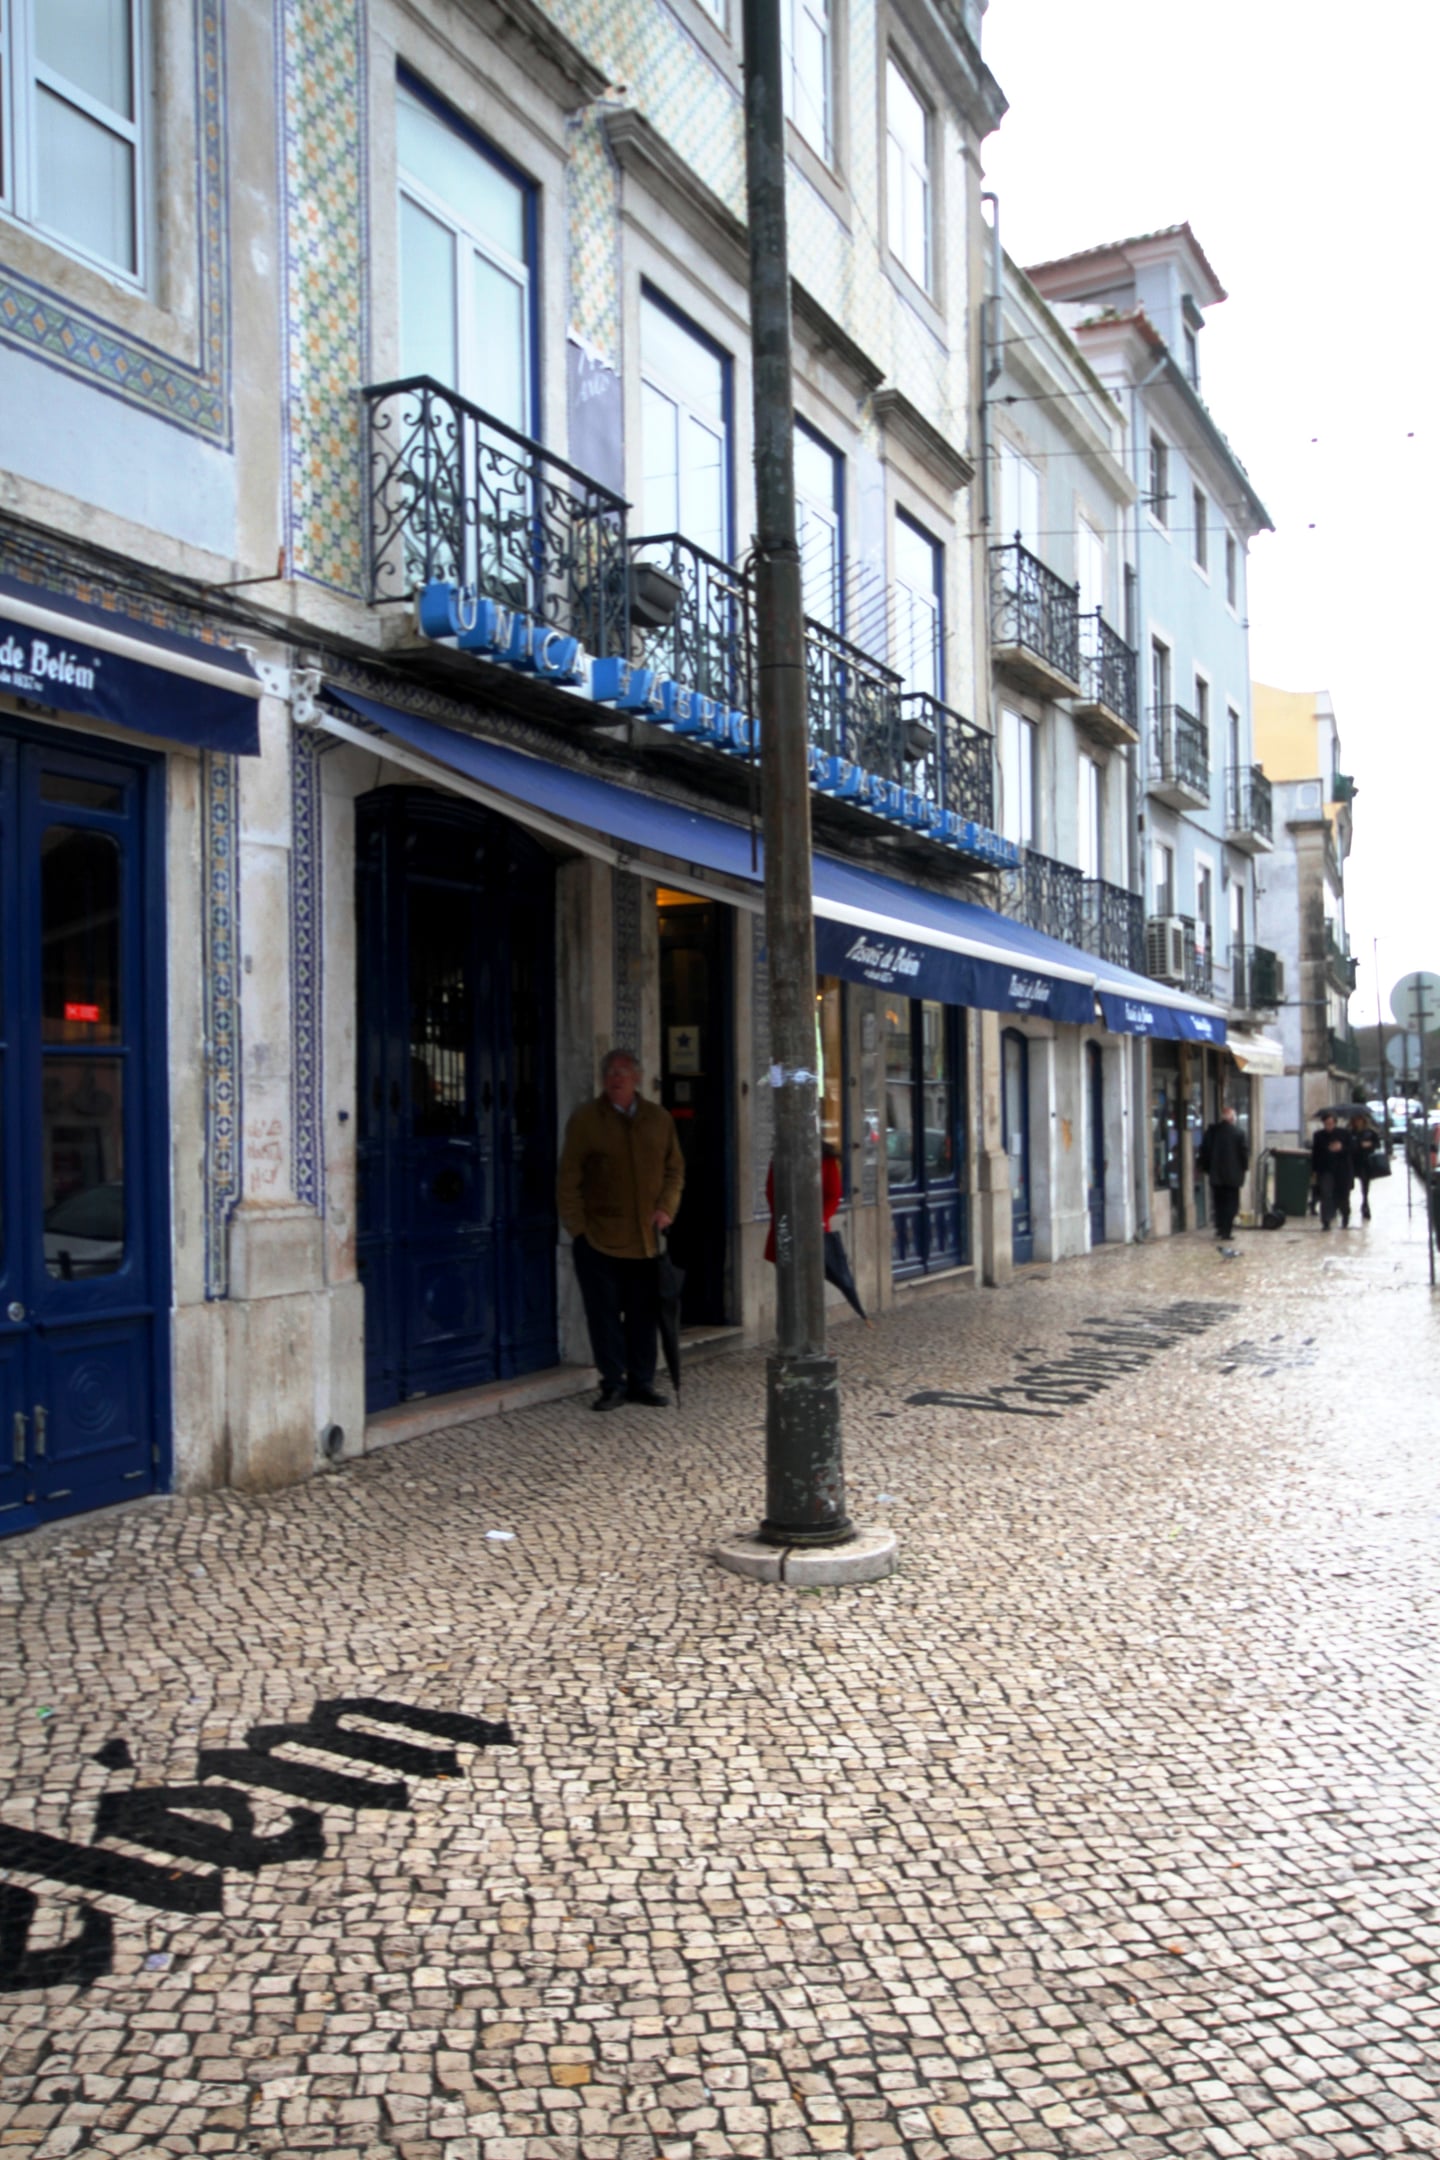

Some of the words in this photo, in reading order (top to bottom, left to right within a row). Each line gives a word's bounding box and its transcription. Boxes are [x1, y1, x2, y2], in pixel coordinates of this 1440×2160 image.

[0, 635, 24, 670] de
[30, 638, 95, 691] Belém
[417, 578, 587, 686] UNICA
[592, 656, 762, 757] FABRIC
[906, 1347, 1156, 1418] Pastéis
